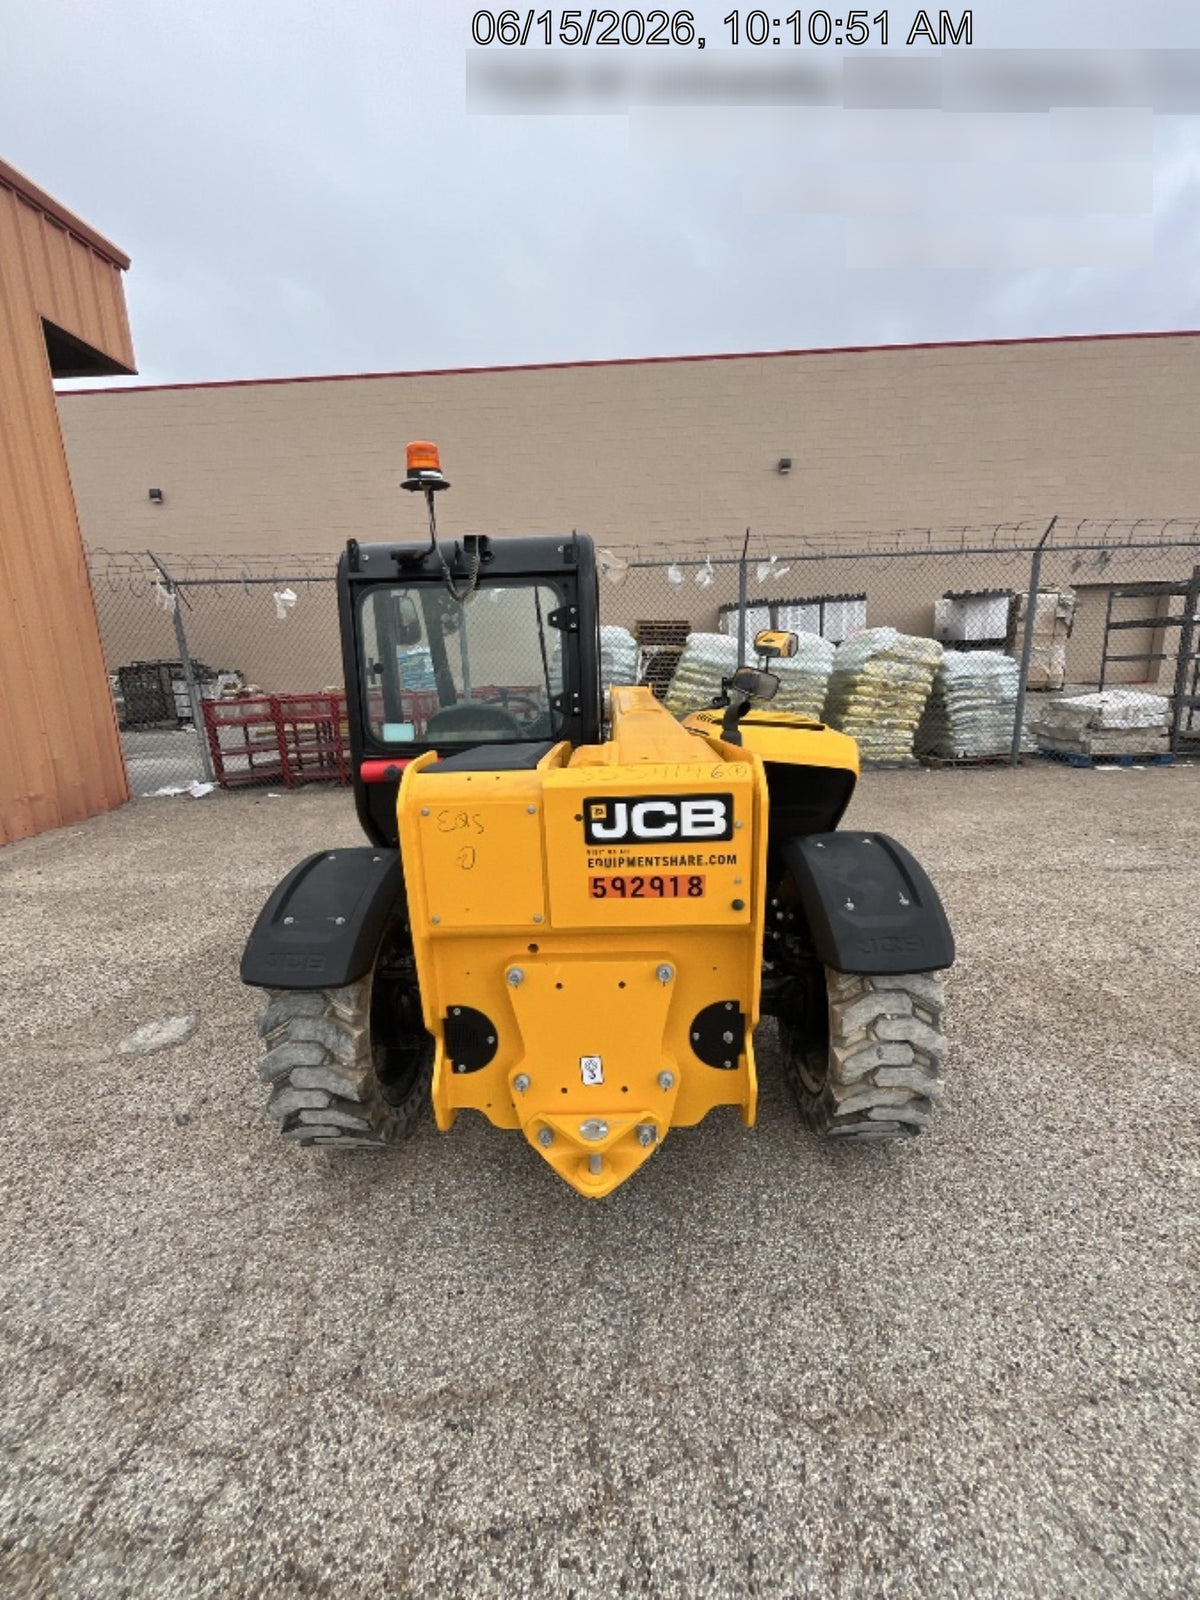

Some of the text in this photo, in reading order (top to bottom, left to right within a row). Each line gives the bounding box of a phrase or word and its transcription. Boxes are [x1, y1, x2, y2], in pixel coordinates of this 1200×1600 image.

[591, 799, 727, 838] JCB
[587, 854, 737, 869] EQUIPMENTSHARE.COM
[592, 875, 703, 899] 592918
